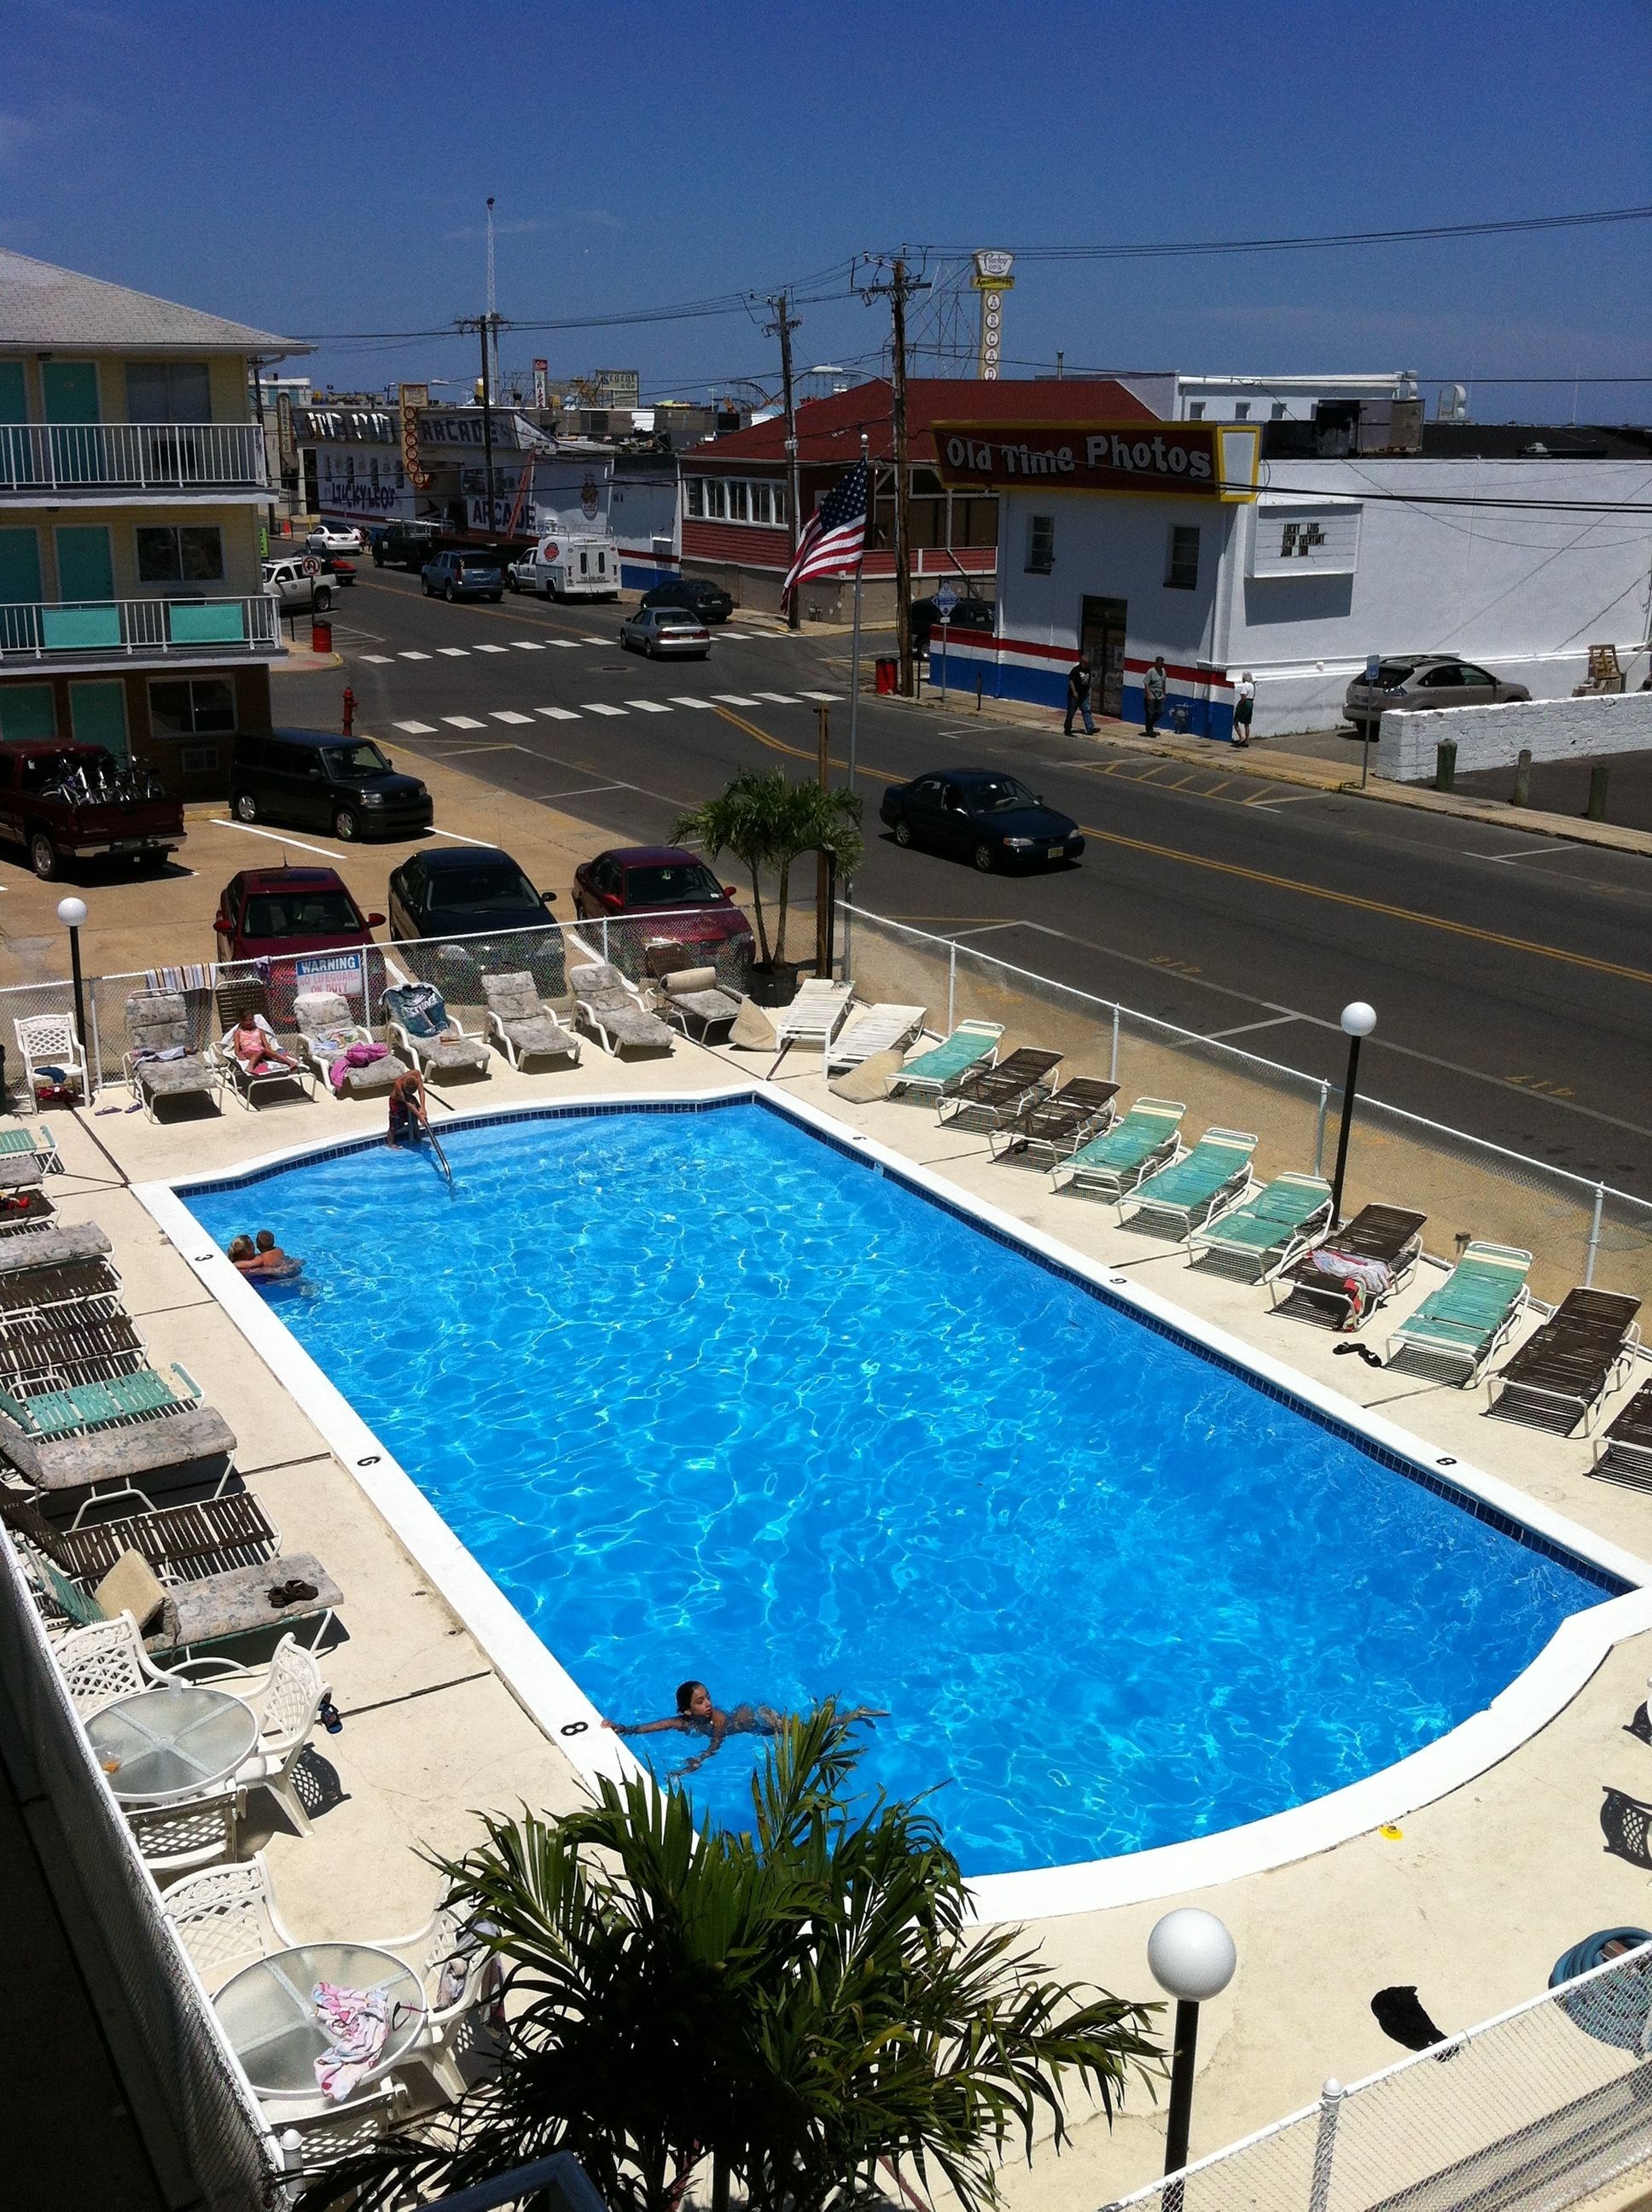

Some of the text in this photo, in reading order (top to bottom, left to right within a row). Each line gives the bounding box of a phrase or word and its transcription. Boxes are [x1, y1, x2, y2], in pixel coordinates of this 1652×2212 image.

[946, 434, 1213, 478] Old Time Photos
[332, 482, 366, 510] LUCKY
[301, 956, 356, 974] WARNING
[300, 970, 359, 987] NO LIFEGUARD
[311, 982, 348, 993] ON DUTY
[195, 1254, 213, 1262] 3
[358, 1455, 381, 1467] 6
[1436, 1457, 1457, 1466] 8
[561, 1721, 589, 1736] 8
